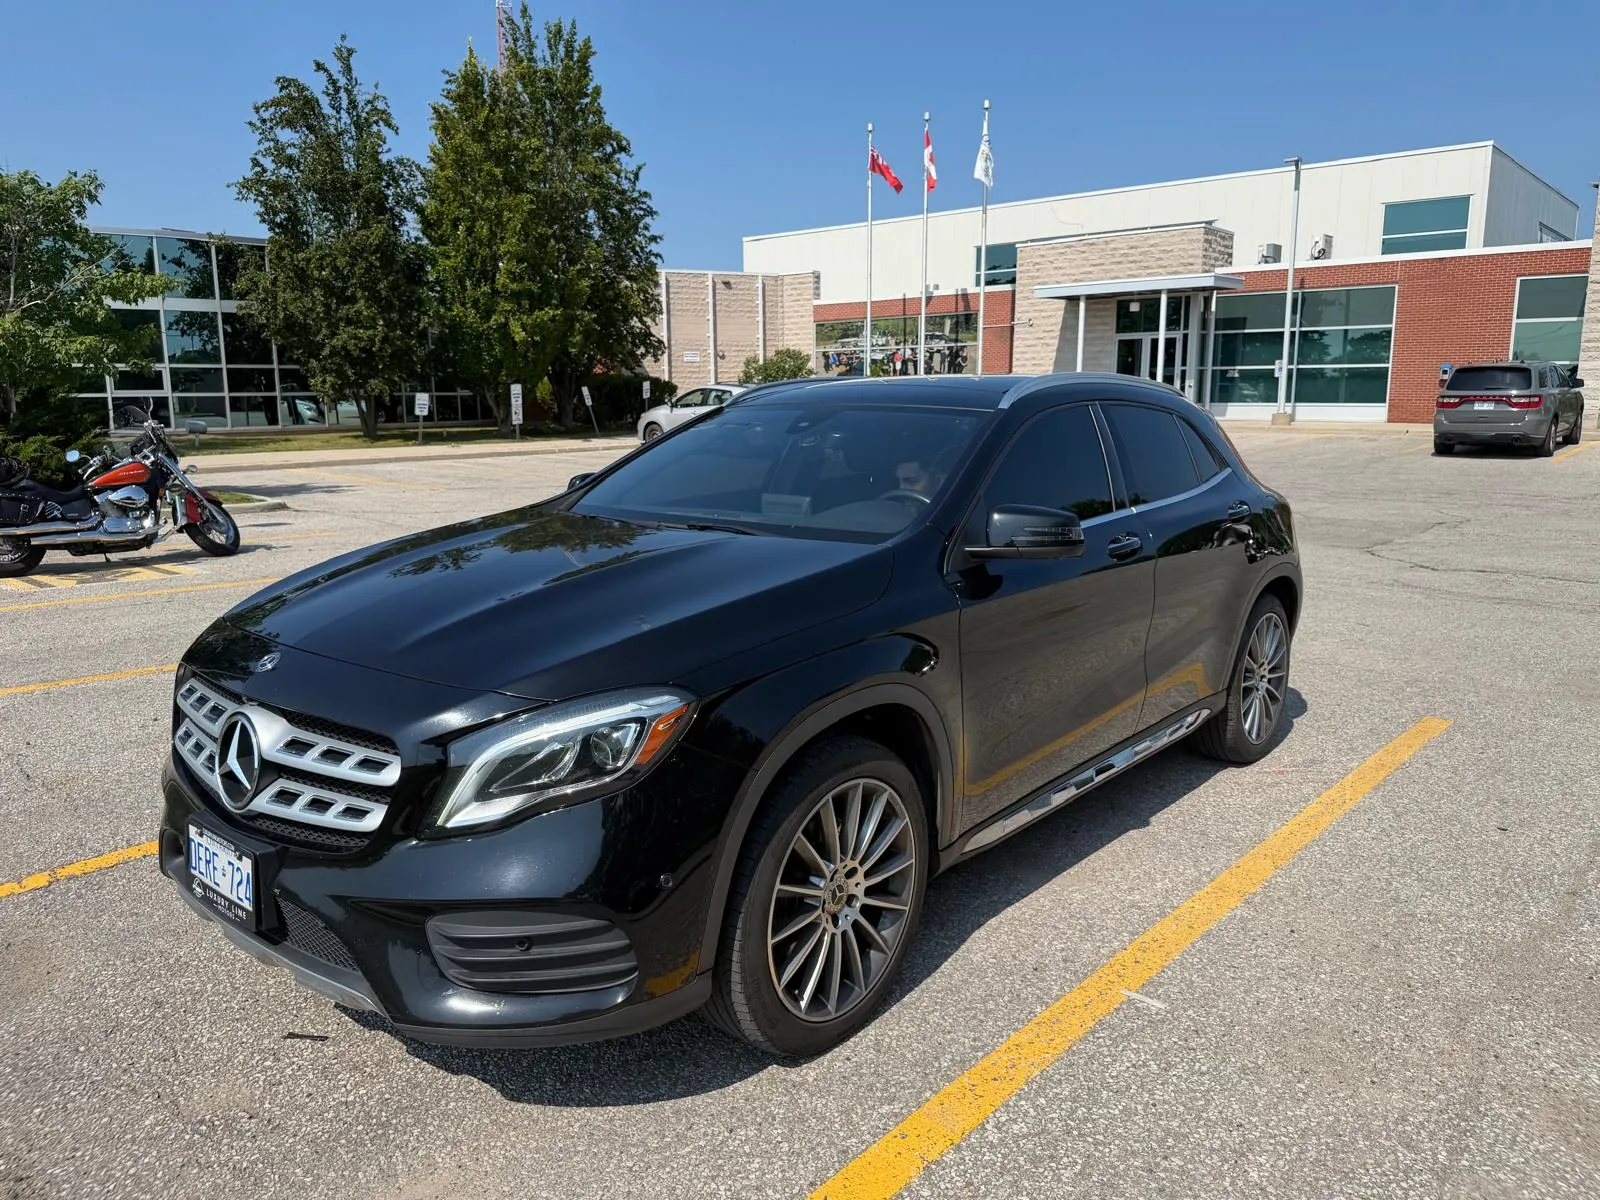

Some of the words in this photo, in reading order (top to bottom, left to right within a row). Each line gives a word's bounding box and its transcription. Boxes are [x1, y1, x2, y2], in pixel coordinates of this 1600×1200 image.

[188, 837, 220, 888] DERE
[227, 860, 253, 906] 724
[206, 888, 229, 909] LUXURY
[231, 904, 247, 920] LINE
